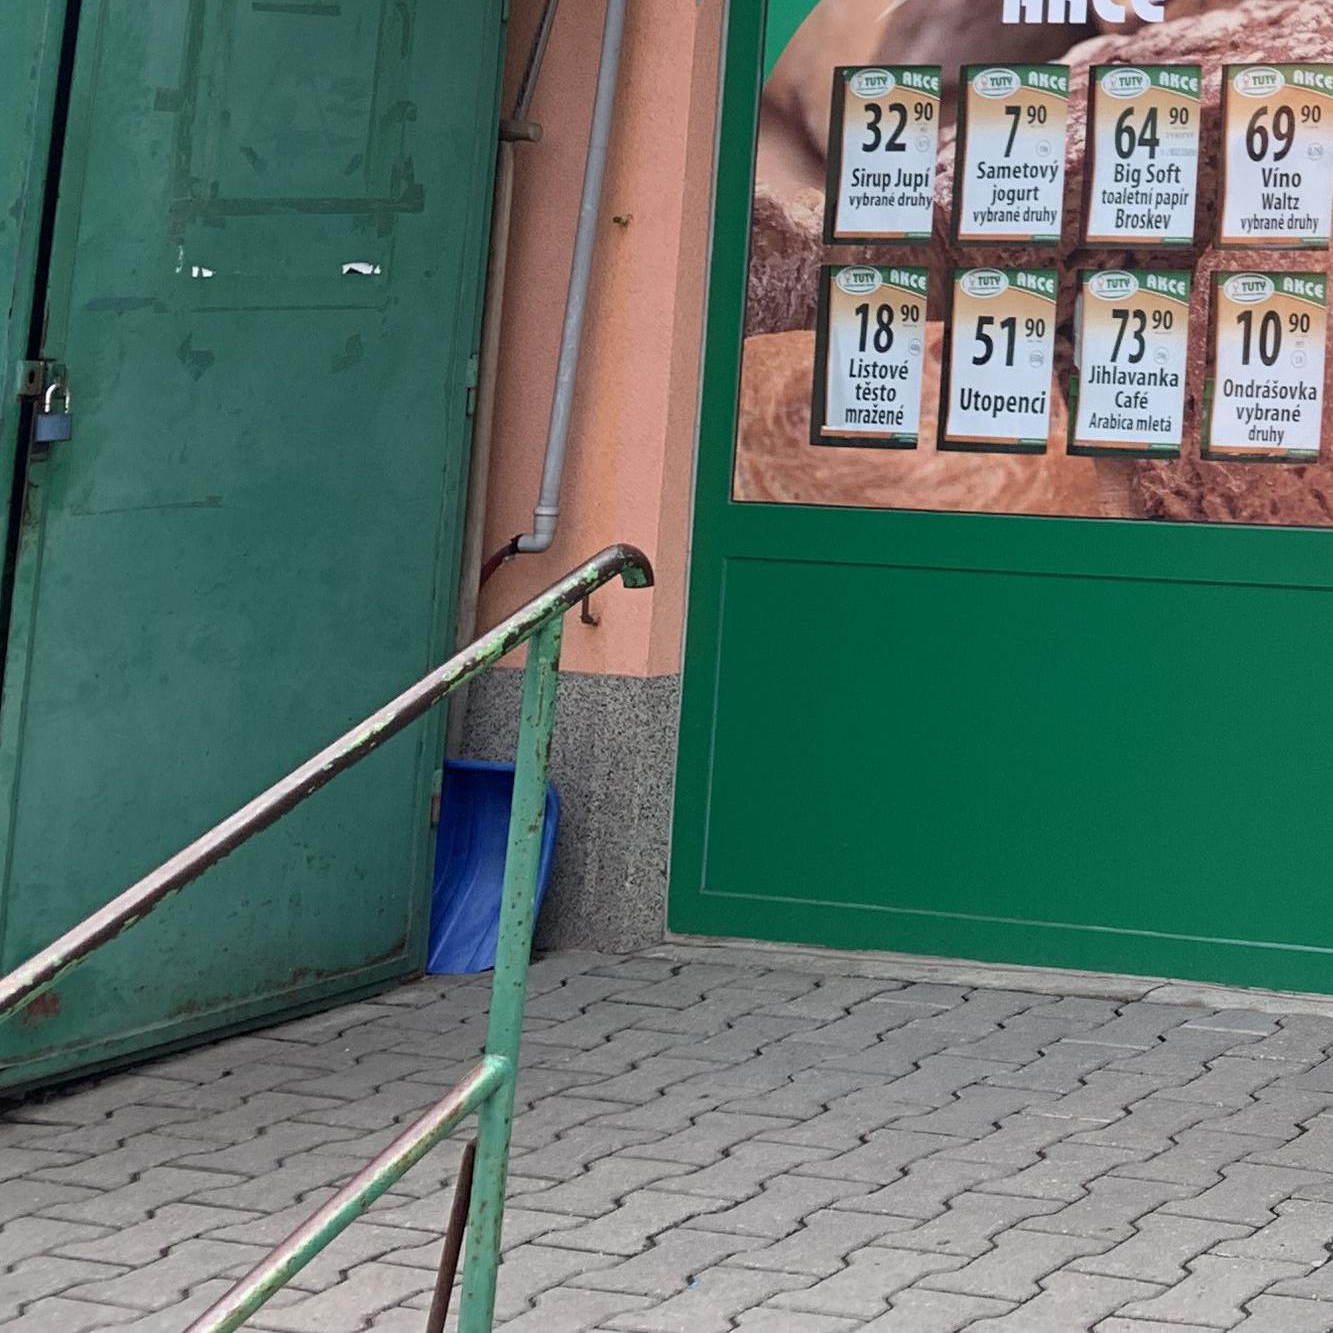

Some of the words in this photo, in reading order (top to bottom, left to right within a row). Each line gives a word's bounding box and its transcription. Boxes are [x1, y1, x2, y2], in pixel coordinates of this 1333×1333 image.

[864, 76, 889, 86] TUTY
[902, 71, 939, 91] AKCE
[989, 76, 1014, 87] TUTY
[1028, 71, 1067, 91] AKCE
[1118, 76, 1144, 87] TUTY
[1159, 71, 1199, 92] AKCE
[1251, 74, 1278, 86] TUTY
[861, 102, 908, 153] 32
[914, 102, 934, 121] 90
[1003, 105, 1022, 158] 7
[1027, 104, 1047, 124] 90
[1114, 106, 1160, 160] 64
[1169, 107, 1190, 125] 90
[1245, 104, 1296, 163] 69
[1301, 104, 1322, 124] 90
[851, 167, 891, 192] Sirup
[894, 167, 931, 192] Jupí
[976, 160, 1059, 183] Sametový
[1114, 163, 1142, 188] Big
[1146, 162, 1182, 184] Soft
[1261, 166, 1302, 188] Víno
[849, 192, 895, 210] vybrané
[897, 192, 933, 210] druhy
[990, 184, 1040, 206] jogurt
[1101, 187, 1153, 206] toaletní
[1155, 187, 1190, 210] papír
[1261, 192, 1301, 211] Waltz
[973, 206, 1020, 226] vybrané
[1023, 205, 1058, 226] druhy
[1115, 208, 1171, 230] Broskev
[1240, 213, 1285, 234] vybrané
[1287, 213, 1319, 234] druhy
[852, 273, 876, 284] TUTY
[890, 269, 928, 290] AKCE
[977, 275, 1001, 286] TUTY
[1016, 272, 1055, 293] AKCE
[1106, 278, 1131, 289] TUTY
[1146, 274, 1186, 296] AKCE
[1241, 281, 1267, 292] TUTY
[1283, 277, 1325, 298] AKCE
[855, 302, 894, 354] 18
[900, 304, 920, 323] 90
[1110, 308, 1147, 364] 73
[1152, 309, 1174, 330] 90
[1236, 309, 1283, 367] 10
[1289, 312, 1311, 333] 90
[971, 315, 1017, 367] 51
[1025, 318, 1046, 338] 90
[849, 358, 909, 380] Listové
[1088, 365, 1180, 387] Jihlavanka
[855, 381, 897, 402] těsto
[1115, 390, 1149, 409] Café
[1222, 378, 1317, 401] Ondrášovka
[960, 387, 1047, 418] Utopenci
[1236, 402, 1302, 425] vybrané
[845, 403, 904, 426] mražené
[1089, 412, 1134, 431] Arabica
[1136, 413, 1172, 432] mletá
[1248, 424, 1286, 446] druhy
